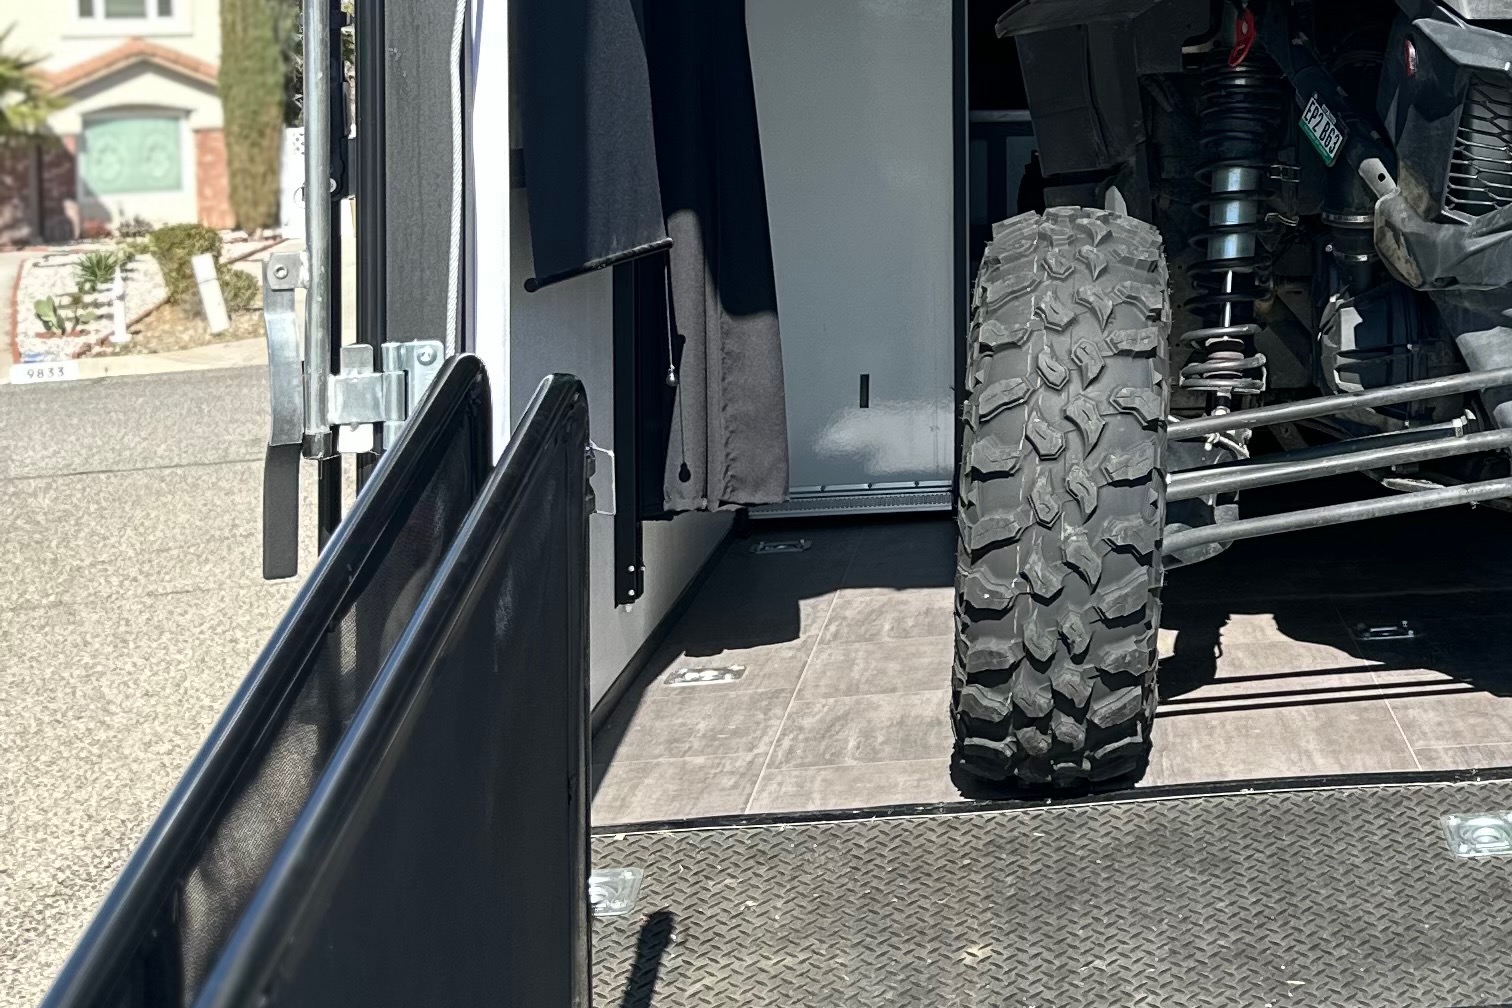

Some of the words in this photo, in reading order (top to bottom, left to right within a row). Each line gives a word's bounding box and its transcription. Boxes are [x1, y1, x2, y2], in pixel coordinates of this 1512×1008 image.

[1304, 101, 1323, 132] EP2
[1319, 121, 1340, 154] B63
[27, 367, 65, 379] 9833
